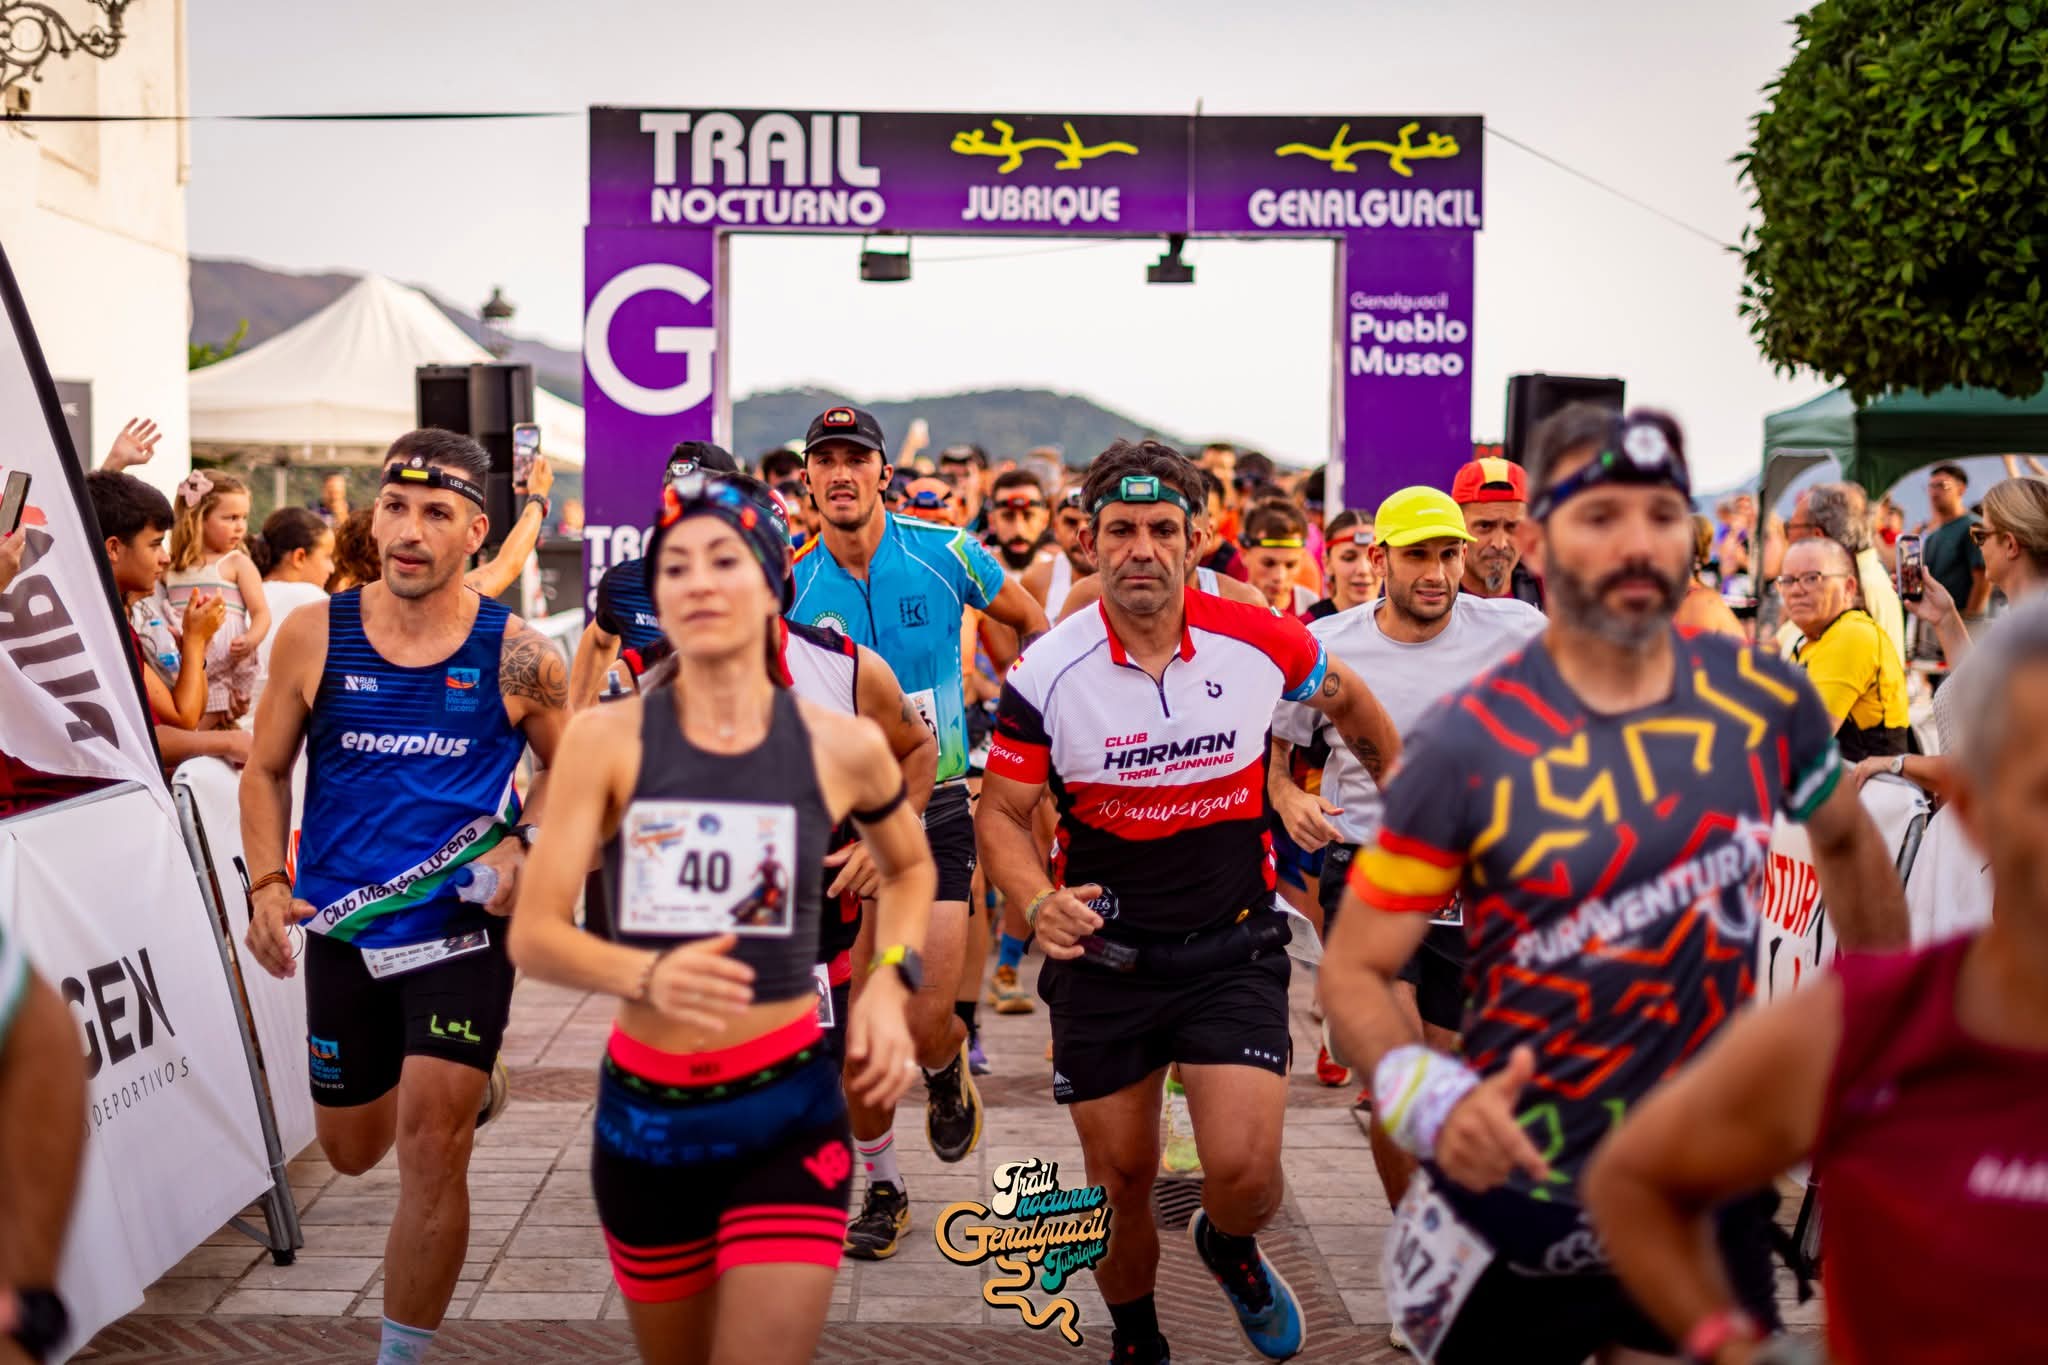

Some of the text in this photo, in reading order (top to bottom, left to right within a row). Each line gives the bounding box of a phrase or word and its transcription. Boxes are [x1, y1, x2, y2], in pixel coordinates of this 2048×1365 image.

[640, 112, 880, 187] TRAIL
[651, 187, 885, 225] NOCTURNO
[962, 185, 1120, 226] JUBRIQUE
[1248, 188, 1481, 227] GENALGUACIL
[1350, 291, 1449, 313] Genalguacil
[584, 263, 717, 415] G
[1350, 311, 1467, 344] Pueblo
[1350, 345, 1465, 376] Museo
[360, 676, 377, 685] RUN
[360, 684, 378, 692] PRO
[341, 732, 471, 757] enerplus
[1103, 730, 1237, 770] HARMAN
[1105, 732, 1148, 748] CLUB
[1118, 752, 1235, 782] TRAIL RUNNING
[1125, 787, 1250, 822] aniversario
[323, 897, 357, 926] Club
[420, 827, 478, 876] Lucena
[677, 850, 732, 894] 40
[93, 1056, 190, 1128] DEPORTIVOS
